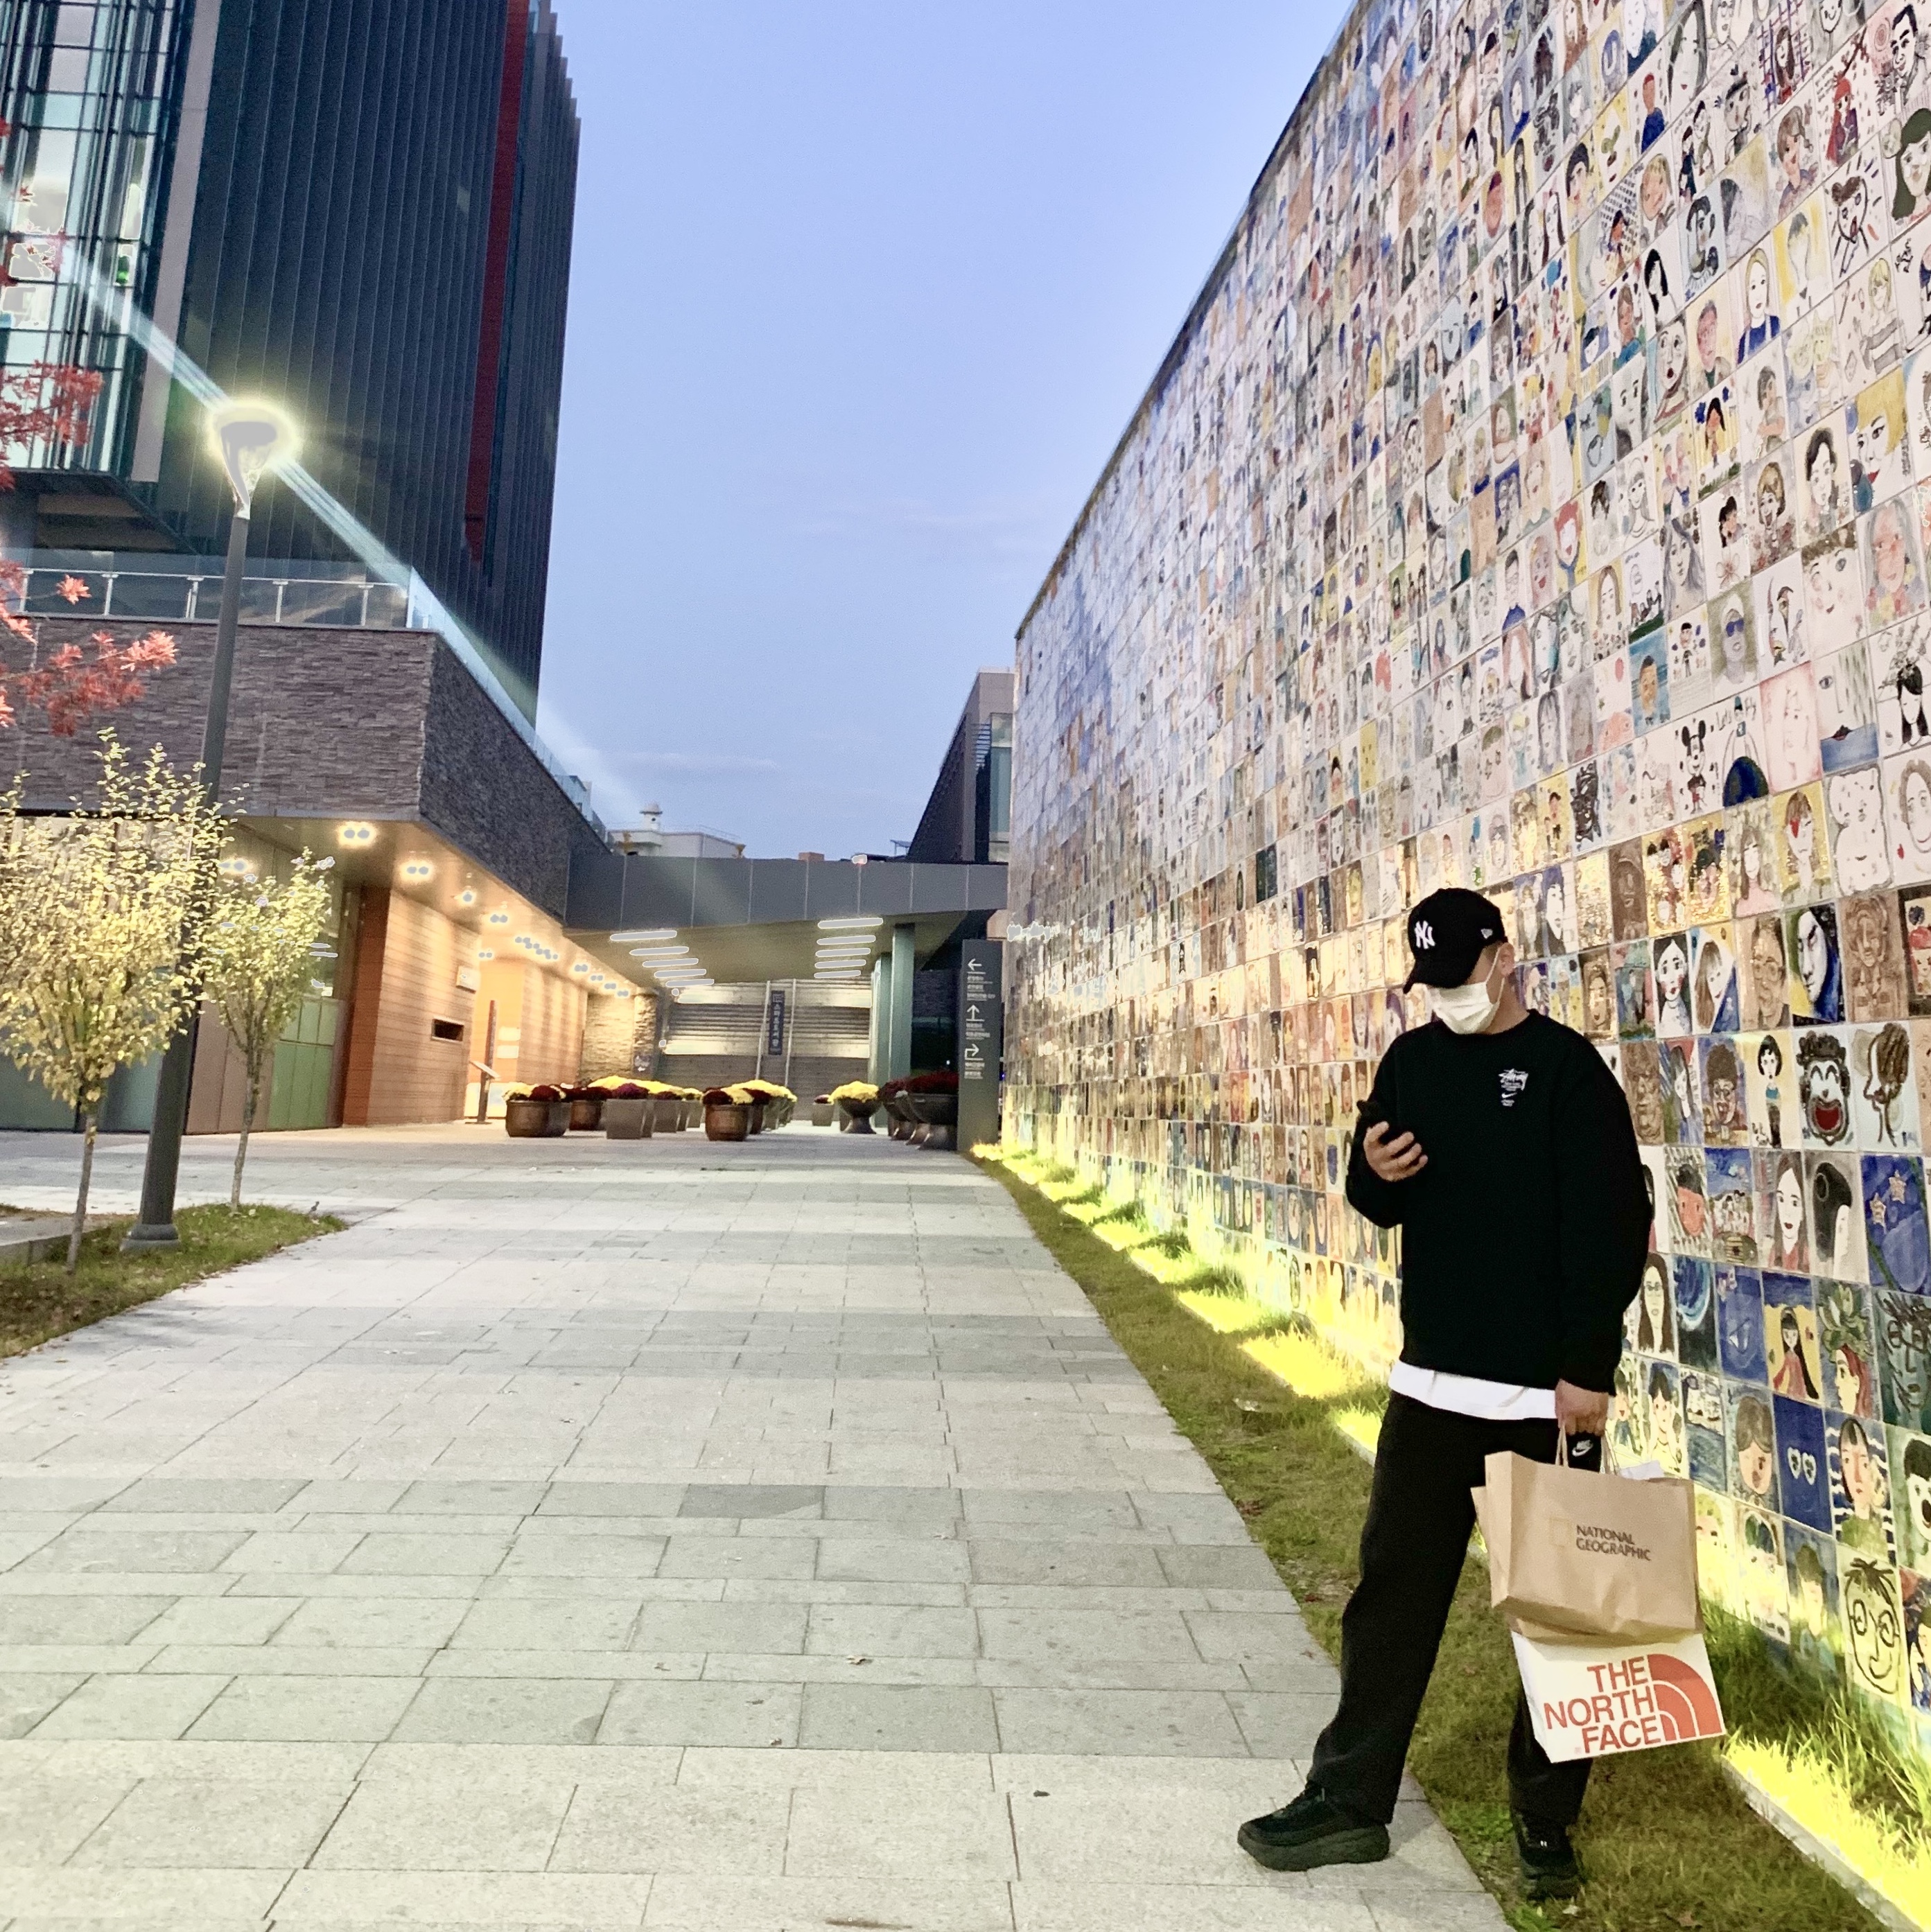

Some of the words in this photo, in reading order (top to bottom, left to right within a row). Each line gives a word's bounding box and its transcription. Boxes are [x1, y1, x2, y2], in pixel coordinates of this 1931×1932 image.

[1414, 920, 1436, 949] NY
[1575, 1538, 1652, 1562] GEOGRAPHIC
[1576, 1525, 1635, 1545] NATIONAL
[1587, 1656, 1648, 1693] THE
[1543, 1685, 1655, 1730] NORTH
[1581, 1714, 1662, 1755] FACE
